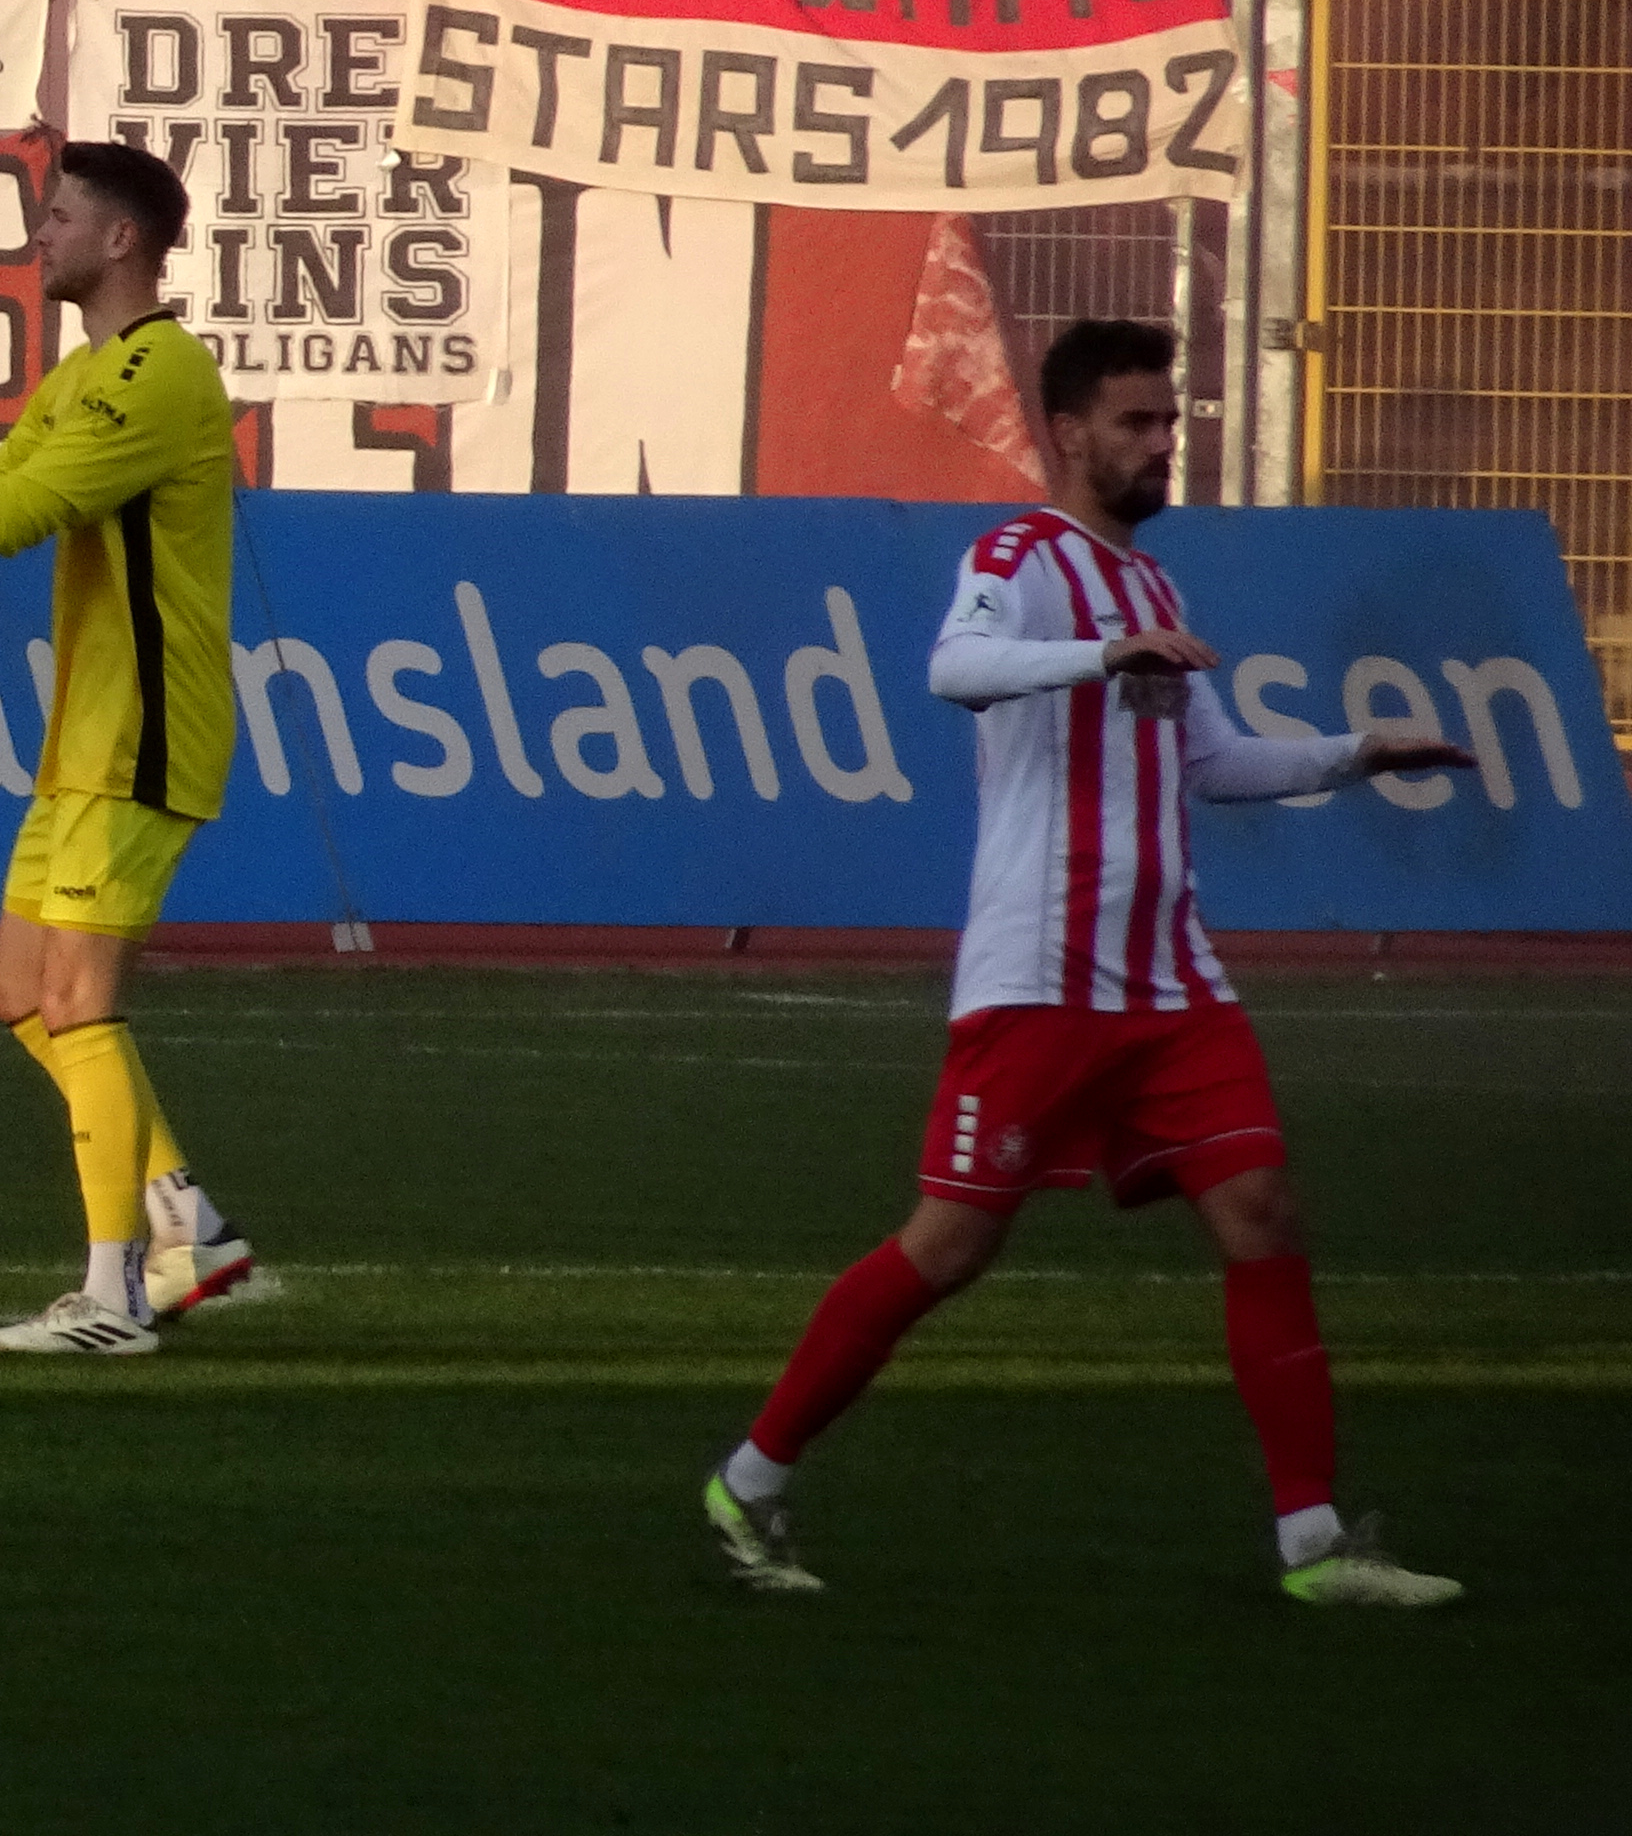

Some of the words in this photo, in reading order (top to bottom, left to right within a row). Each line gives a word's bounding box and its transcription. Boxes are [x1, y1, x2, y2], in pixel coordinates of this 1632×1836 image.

[116, 9, 407, 114] DRE
[412, 3, 876, 185] STARS
[889, 48, 1240, 190] 1982
[196, 332, 479, 375] OLIGANS
